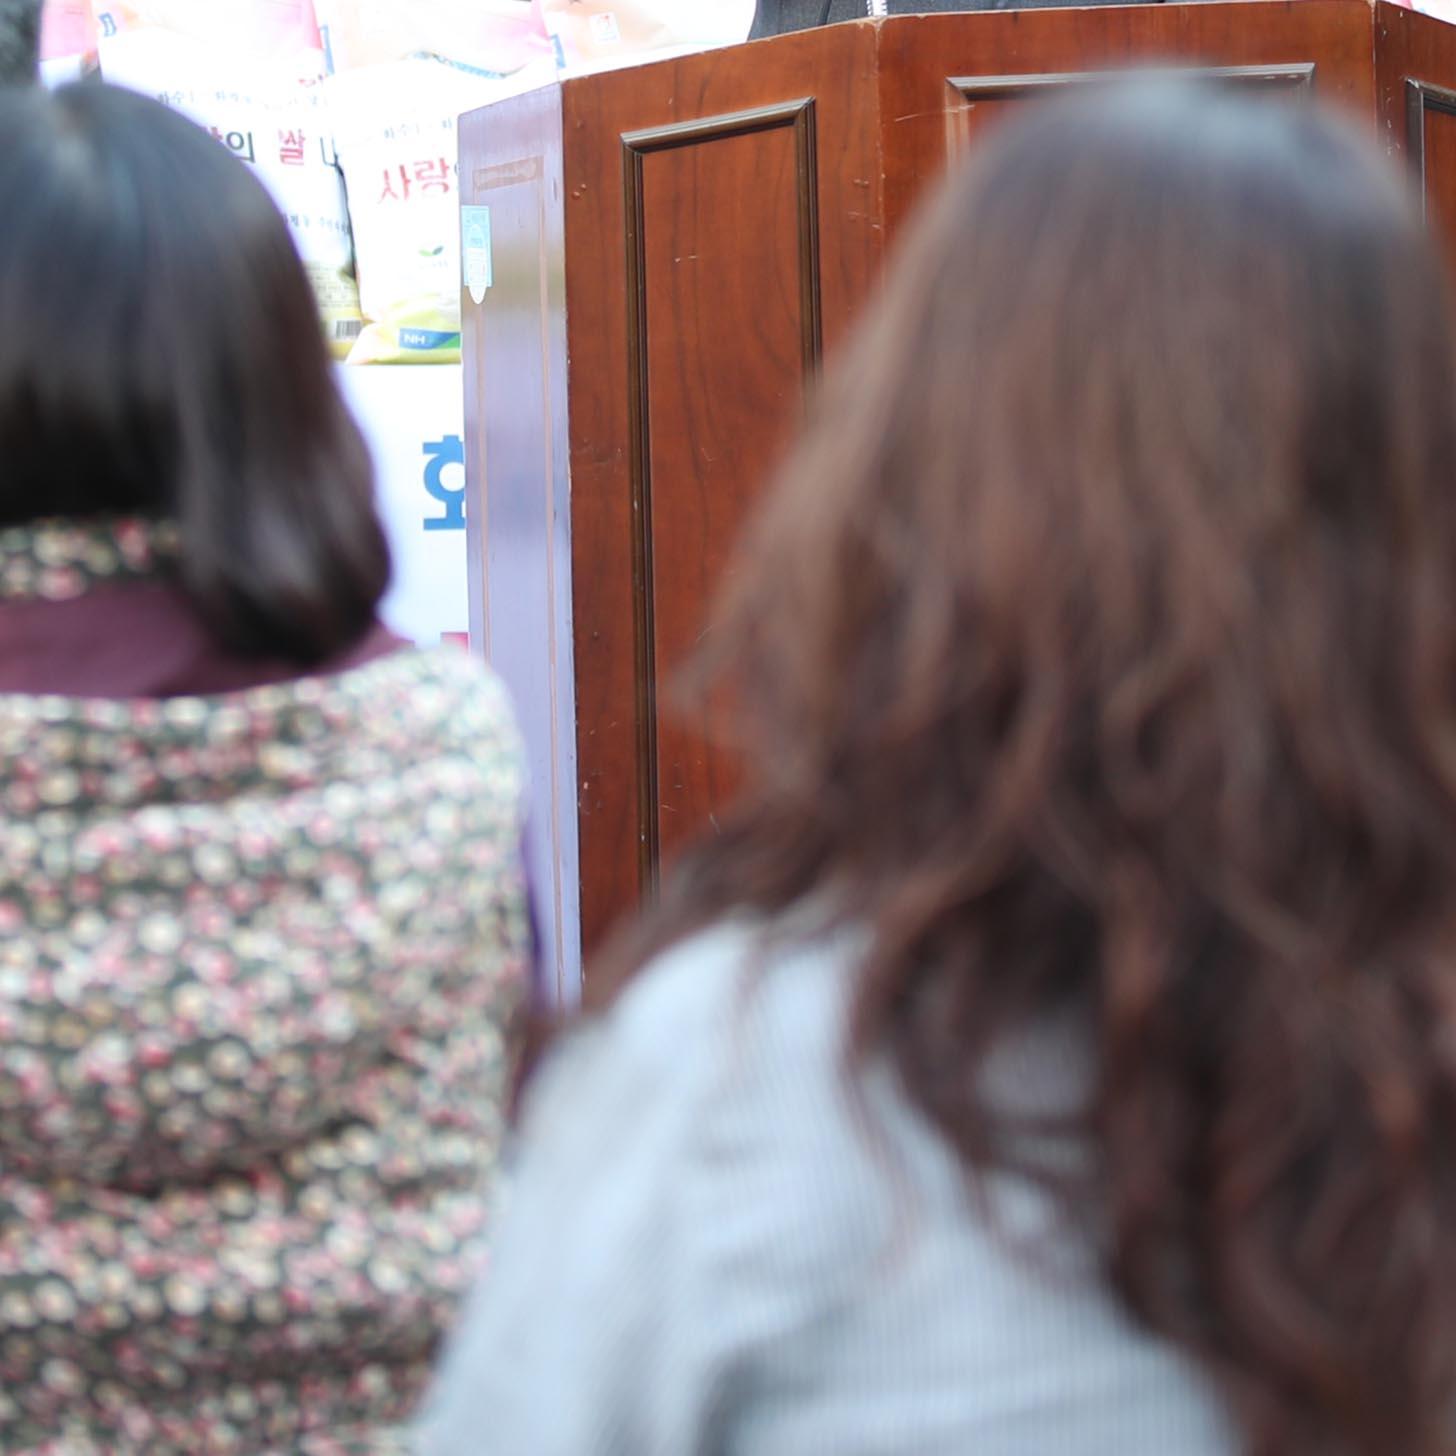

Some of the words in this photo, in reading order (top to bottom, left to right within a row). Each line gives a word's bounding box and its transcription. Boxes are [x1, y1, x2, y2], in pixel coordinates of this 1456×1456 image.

[278, 128, 306, 166] 쌀
[377, 157, 460, 204] 사랑
[403, 333, 426, 345] NH
